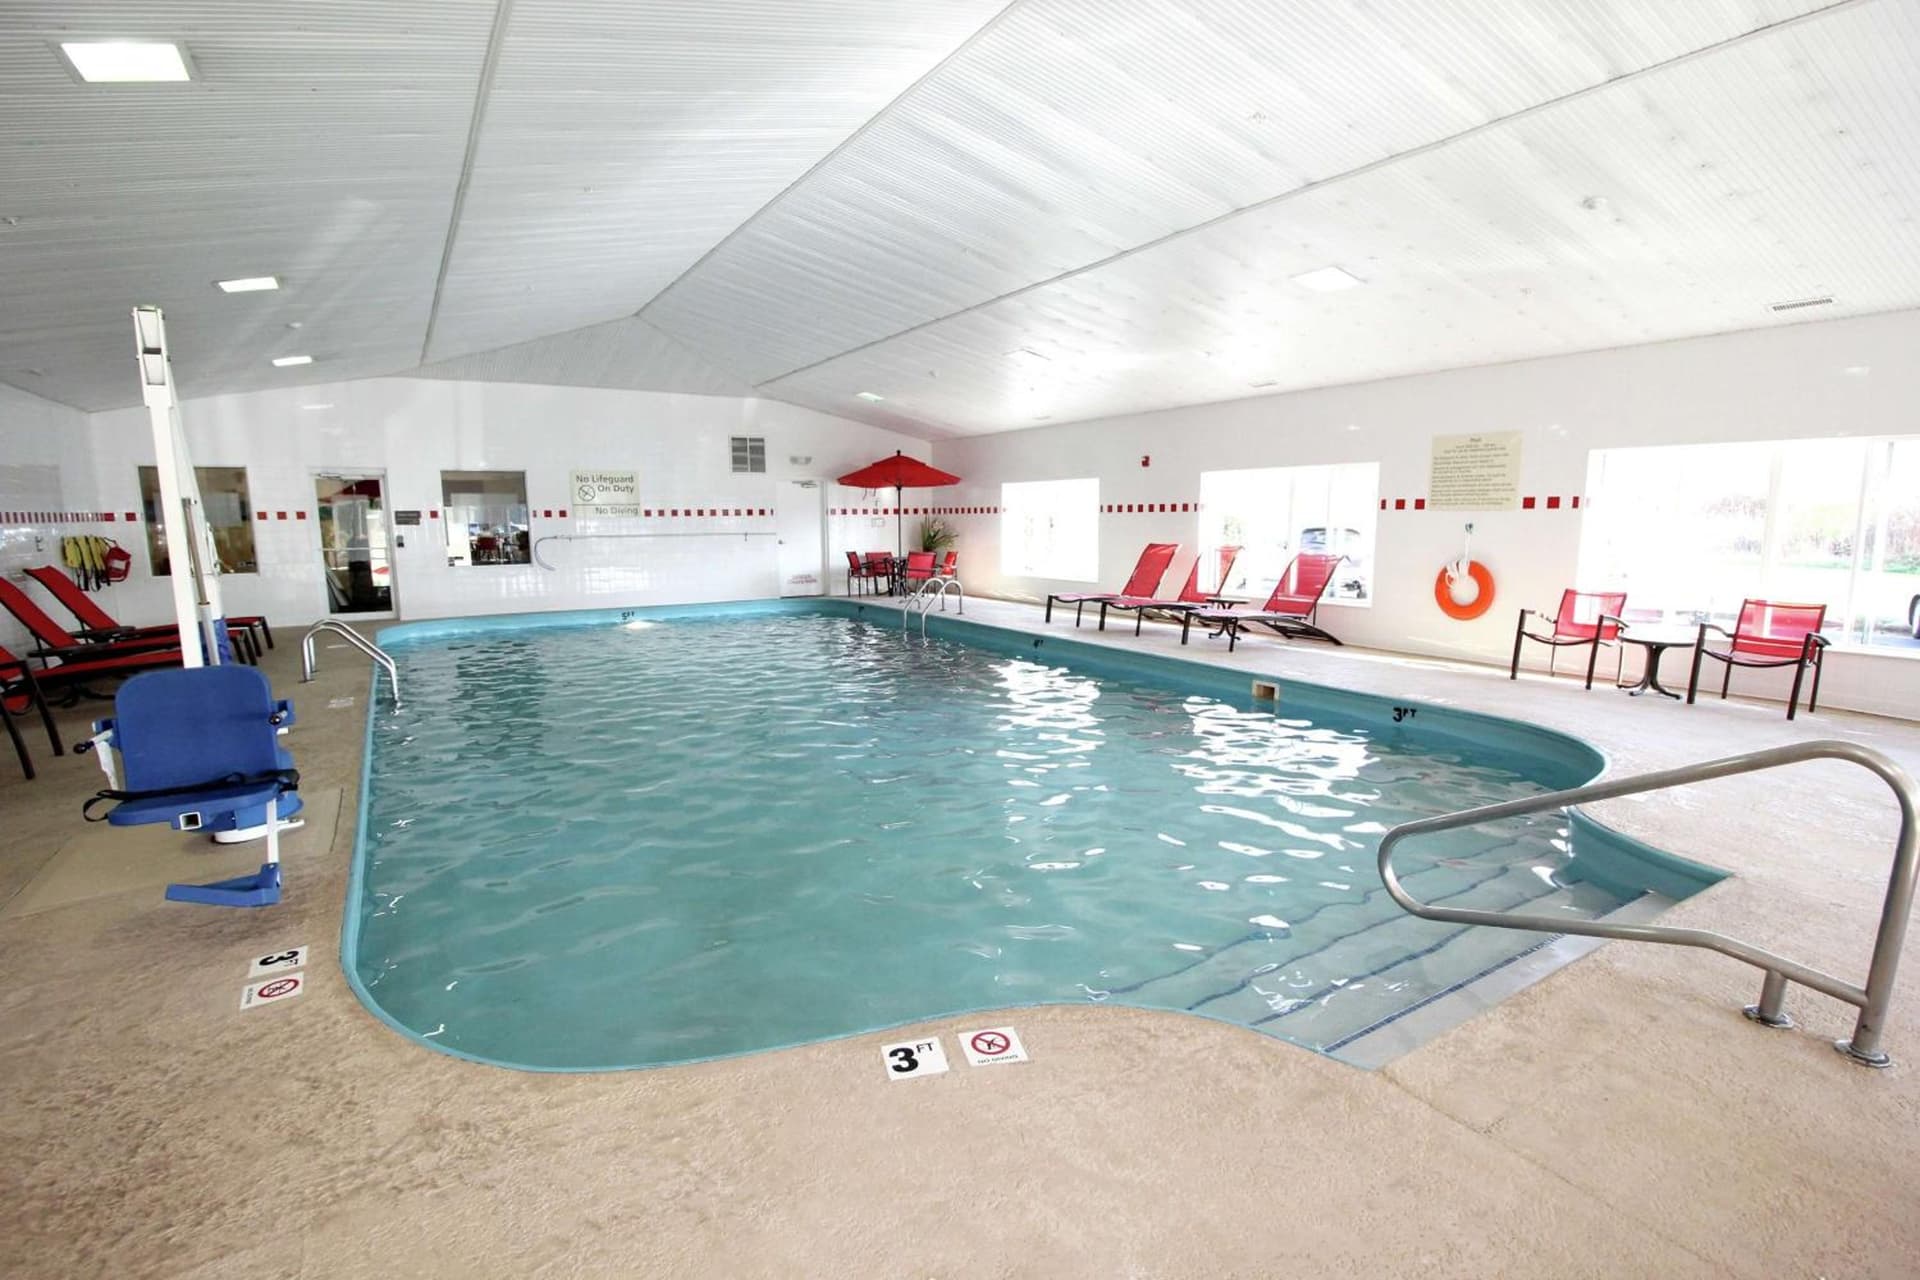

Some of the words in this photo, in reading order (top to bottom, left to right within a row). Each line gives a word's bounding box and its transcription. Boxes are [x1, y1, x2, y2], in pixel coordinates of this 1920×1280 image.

[576, 474, 589, 483] No
[592, 474, 634, 484] Lifeguard
[613, 484, 634, 495] Duty
[611, 507, 639, 516] Diving
[259, 951, 299, 966] 3
[889, 1047, 919, 1073] 3
[916, 1042, 934, 1053] FT
